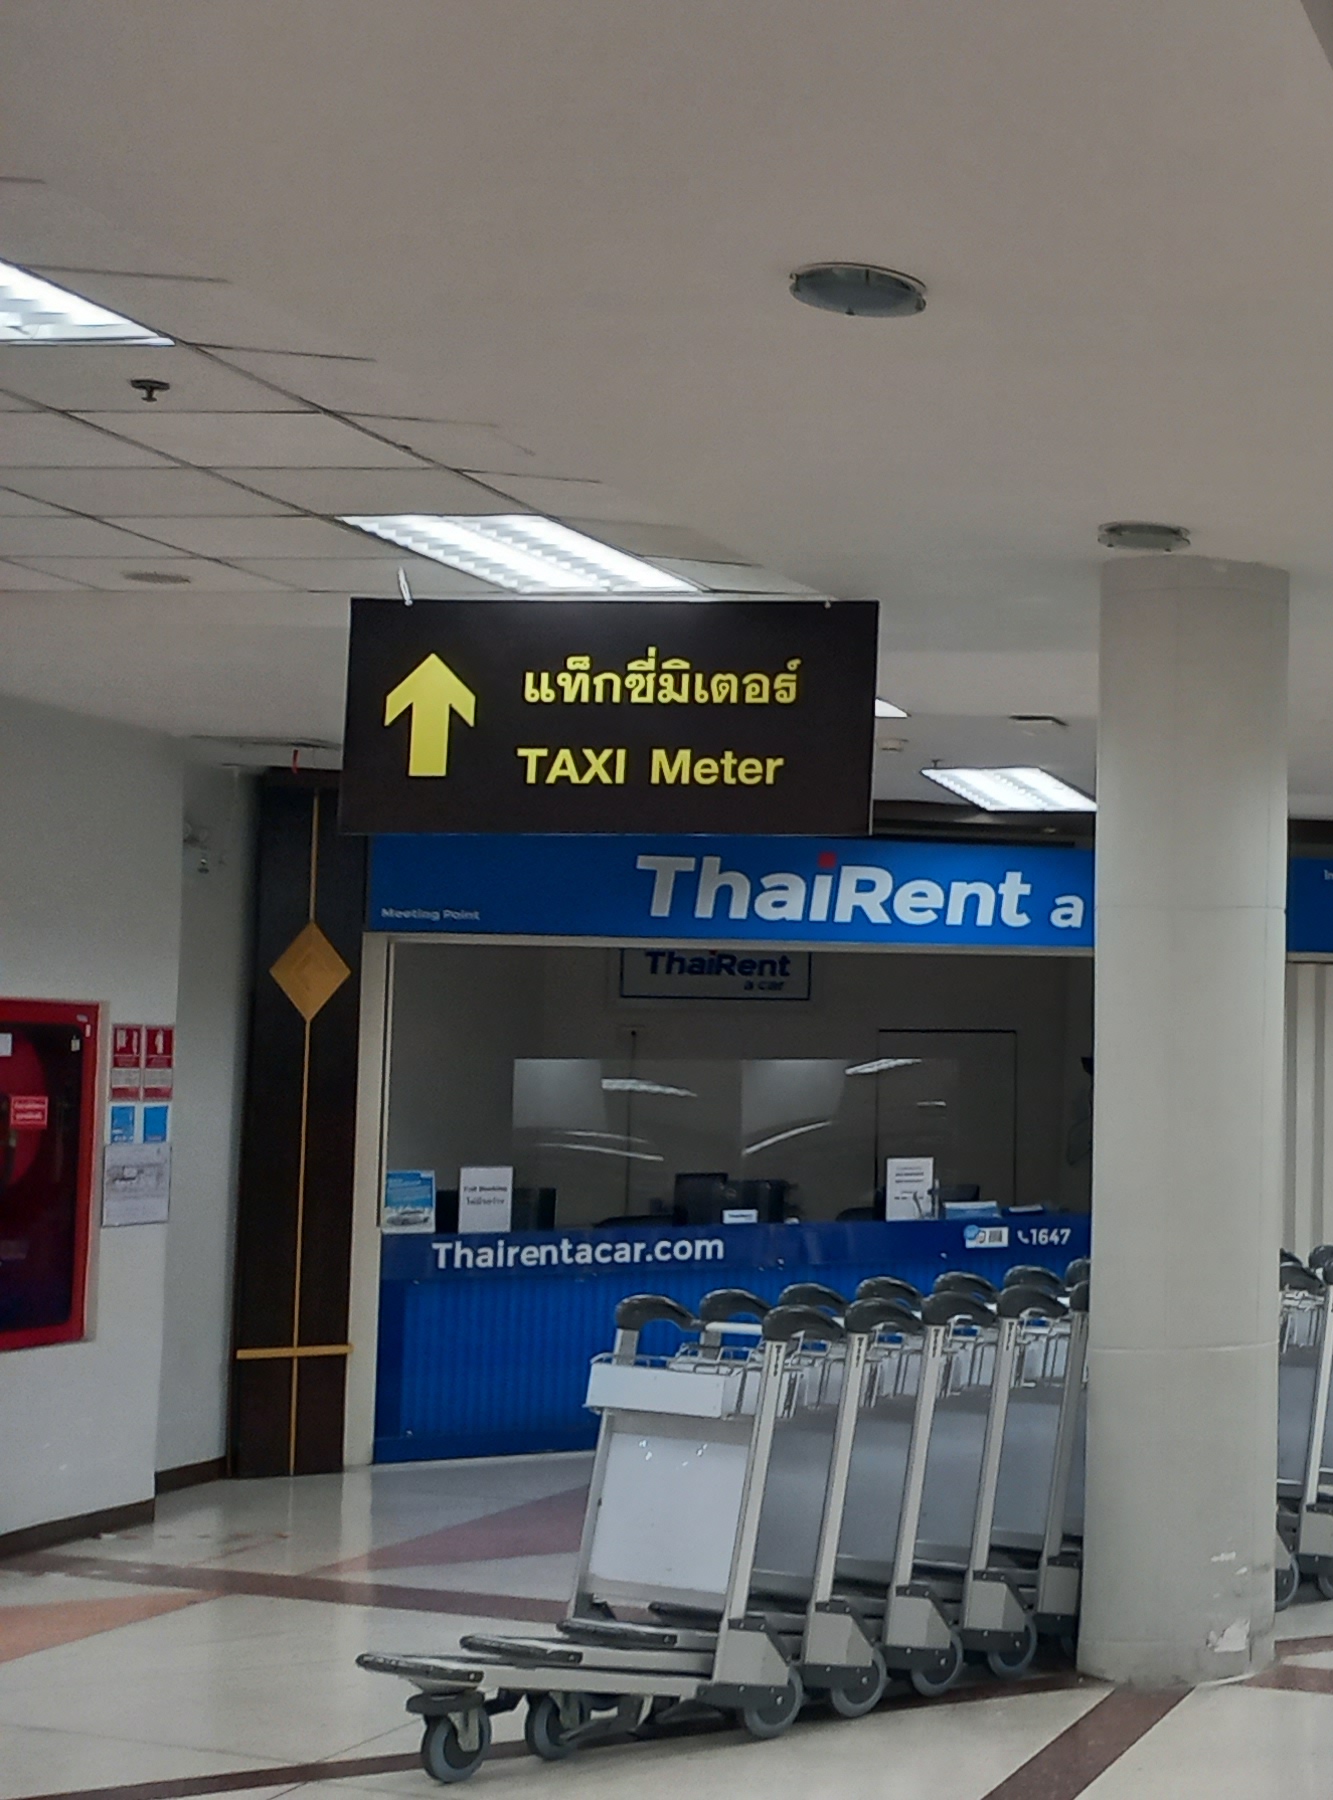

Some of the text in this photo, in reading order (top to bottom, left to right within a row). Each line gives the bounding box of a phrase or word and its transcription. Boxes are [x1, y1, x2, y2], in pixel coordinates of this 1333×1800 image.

[523, 647, 801, 704] แท็กซี่มิเตอร์
[517, 747, 785, 785] TAXI Meter
[636, 852, 1031, 927] ThaiRent
[381, 907, 480, 921] Meeting Point
[645, 950, 791, 977] ThaiRent
[1030, 1227, 1072, 1245] 1647
[432, 1237, 725, 1269] Thairentacar.com
